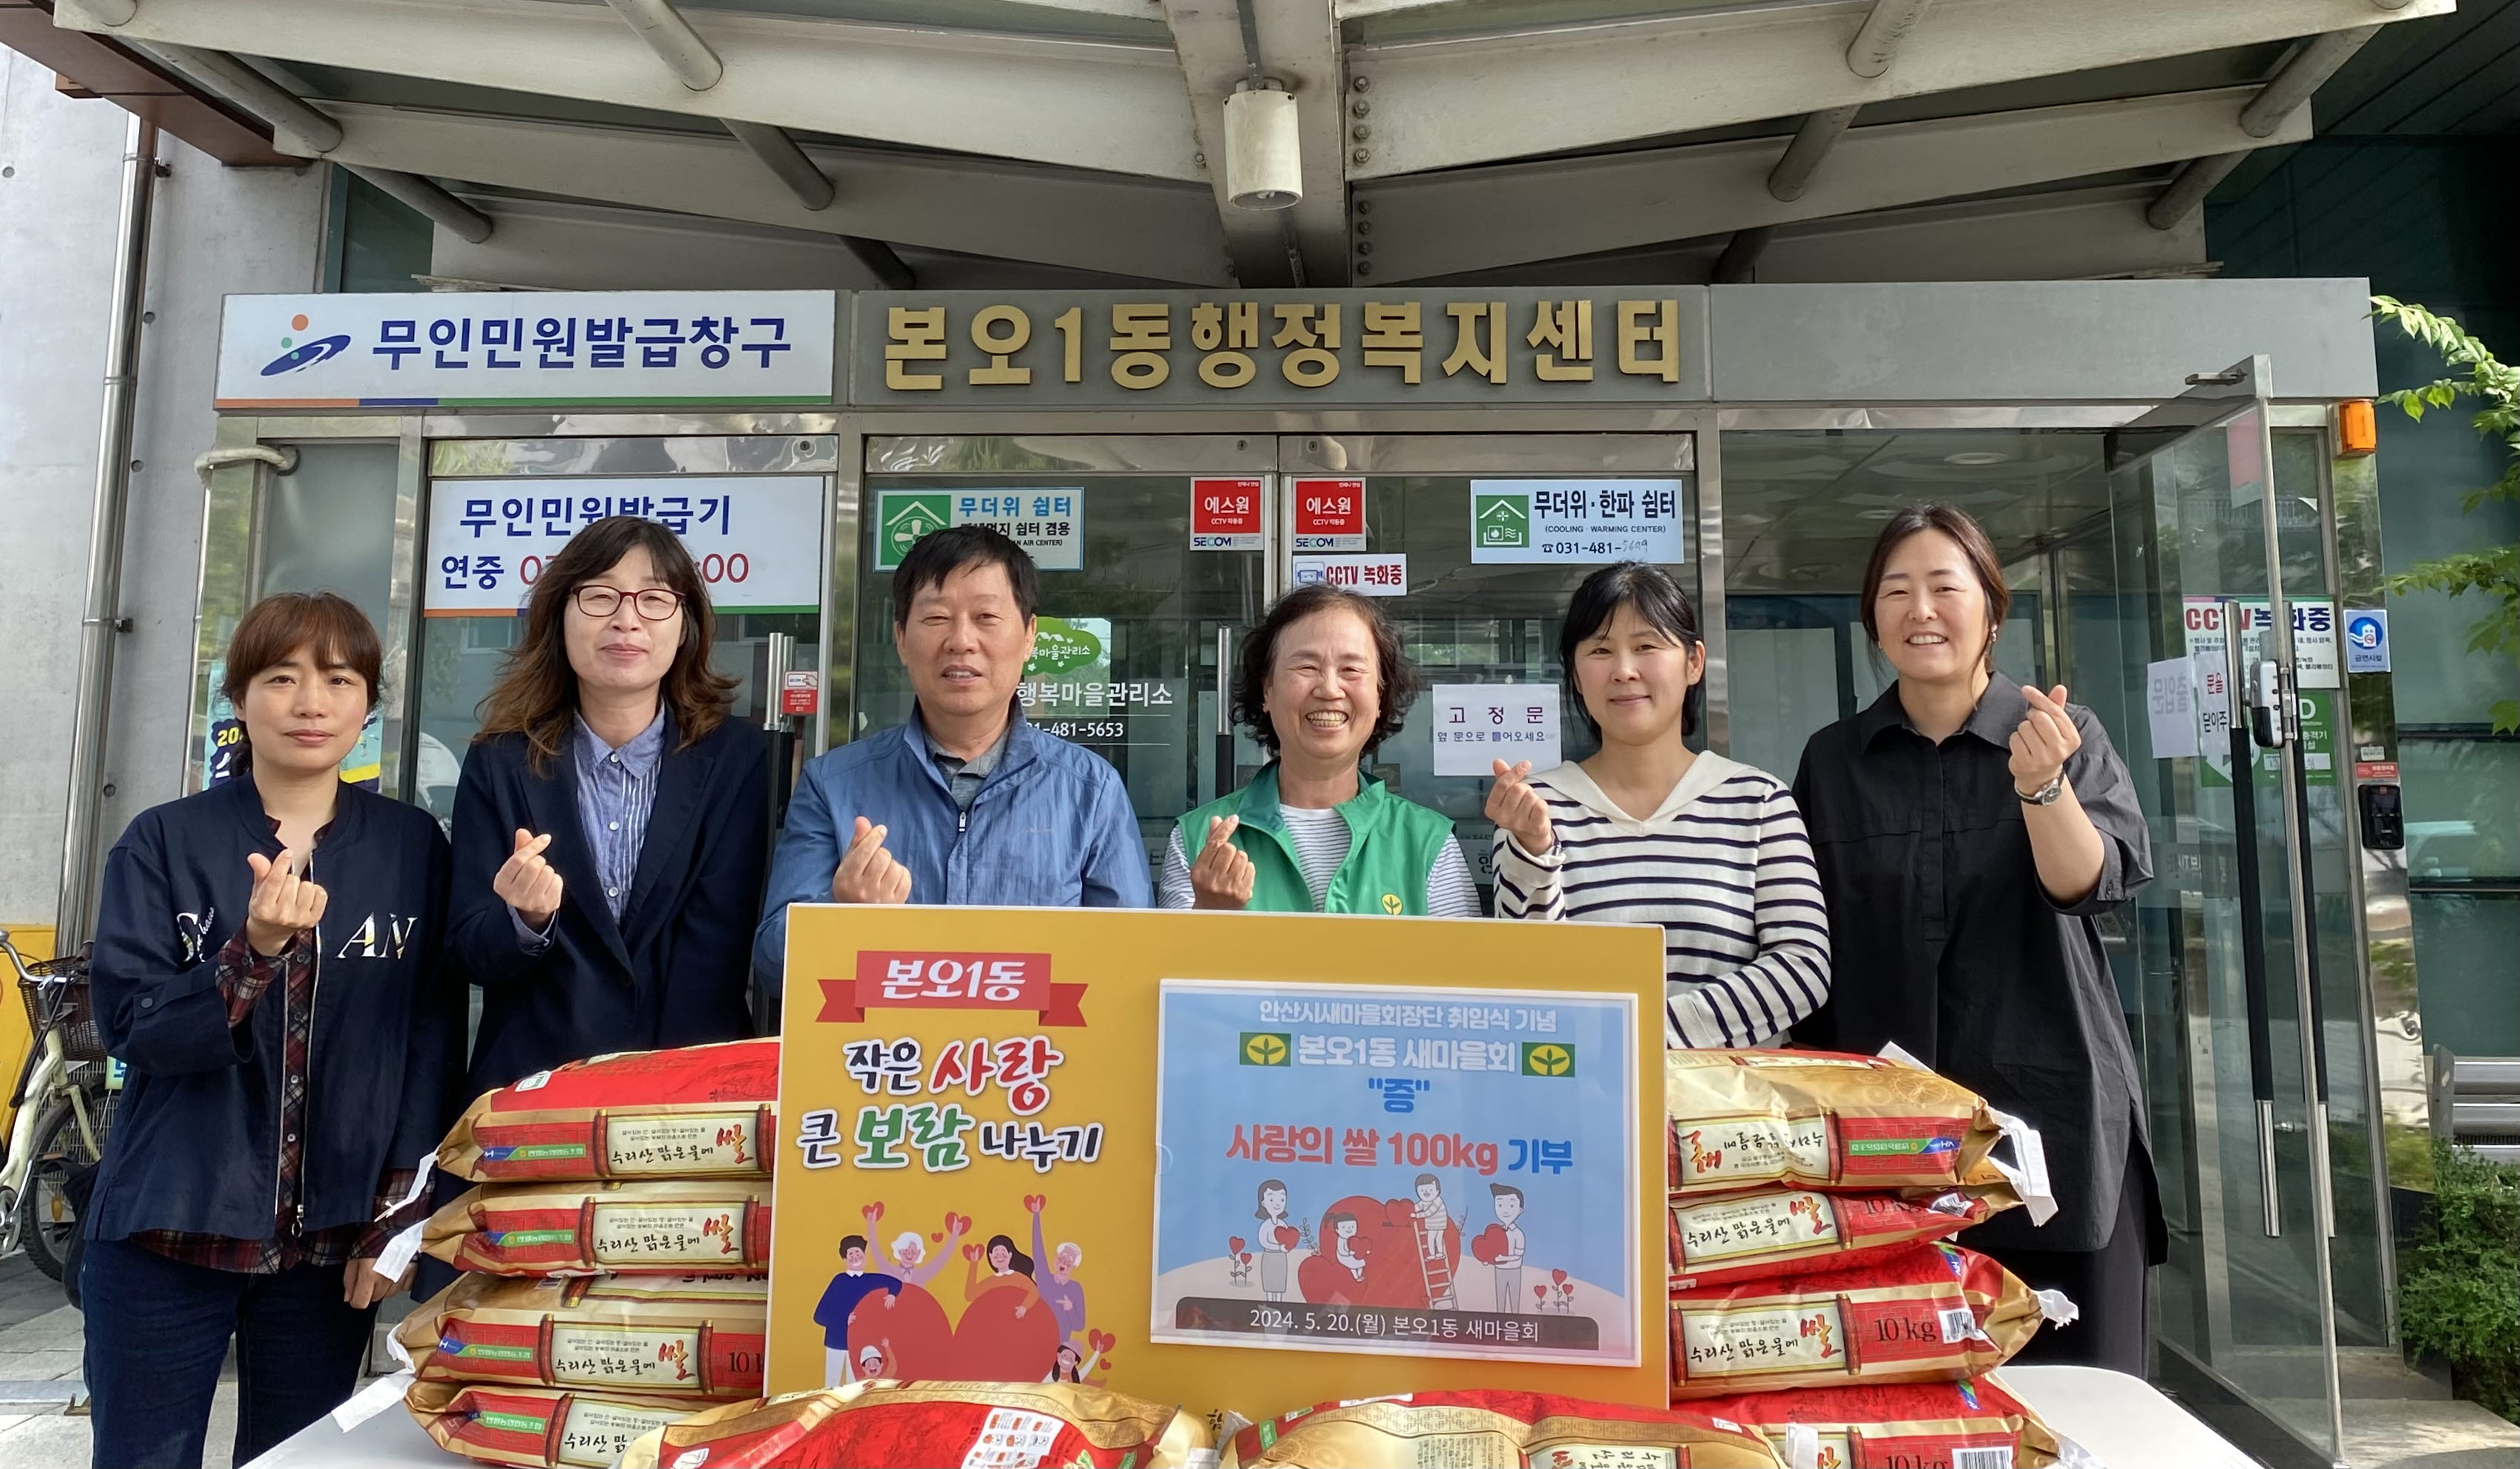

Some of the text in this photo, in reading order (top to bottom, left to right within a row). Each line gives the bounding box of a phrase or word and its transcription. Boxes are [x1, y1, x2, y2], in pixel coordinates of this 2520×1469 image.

[373, 315, 792, 371] 무인민원발급창구
[885, 300, 1679, 390] 본오1동행정복지센터
[959, 497, 1072, 517] 무더위 쉼터
[1204, 497, 1249, 514] 에스원
[1306, 497, 1351, 515] 에스원
[1641, 490, 1676, 519] 쉼터
[1016, 522, 1040, 536] 쉼터
[1046, 522, 1071, 536] 겸용
[1036, 539, 1063, 547] CENTER)
[1194, 537, 1231, 546] SECOM
[1296, 538, 1333, 547] SECOM
[442, 554, 505, 590] 연중
[1326, 565, 1402, 586] CCTV 녹화중
[2186, 608, 2251, 630] CCV
[1030, 644, 1091, 660] 복마을관리소
[2355, 654, 2383, 662] 금연시설
[1017, 682, 1173, 707] 행복마을관리소
[1449, 707, 1543, 724] 고 정 문
[217, 727, 244, 747] 20
[1437, 732, 1447, 742] 옆
[1454, 732, 1486, 742] 문으로
[880, 960, 1026, 1001] 본오1동
[1259, 1000, 1557, 1033] 안산시새마을회장단 취임식 기념
[1299, 1034, 1515, 1073] 본오1동 새마을회
[844, 1036, 1063, 1113] 작은 사랑
[797, 1103, 1103, 1171] 큰 보람 나누기
[611, 1147, 654, 1164] 수리산
[1226, 1123, 1573, 1176] 사랑의 쌀 100kg 기부
[597, 1237, 638, 1253] 수리산
[1687, 1227, 1730, 1247] 수리산
[1250, 1309, 1299, 1329] 2024.
[1305, 1313, 1326, 1330] 5.
[1392, 1316, 1459, 1339] 본오1동
[1465, 1319, 1539, 1343] 새마을회
[1875, 1317, 1937, 1342] 10 kg
[1690, 1344, 1734, 1363] 수리산
[556, 1358, 596, 1375] 수리산
[564, 1434, 608, 1453] 수리산
